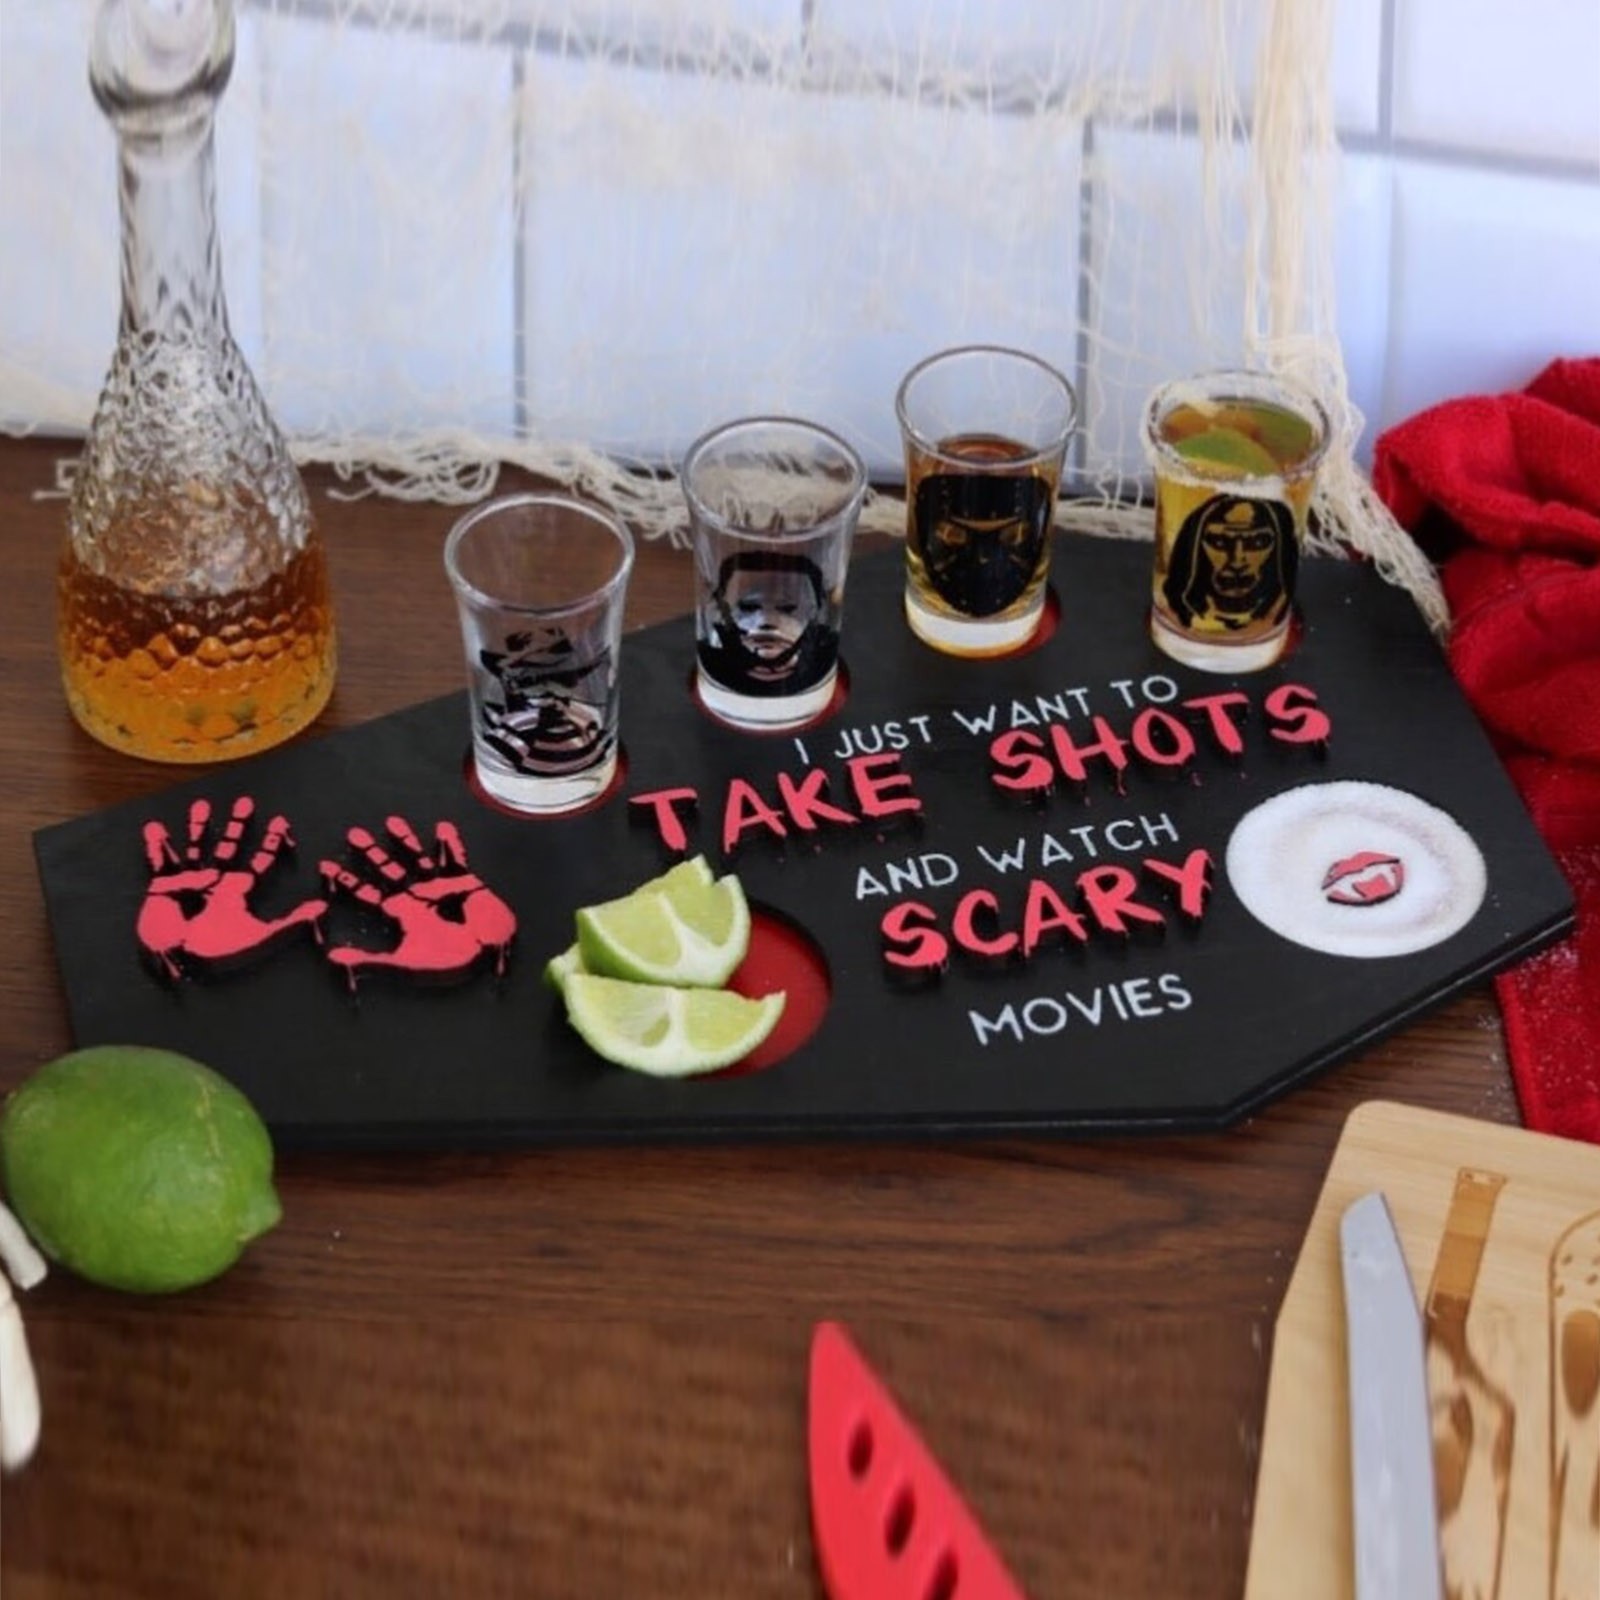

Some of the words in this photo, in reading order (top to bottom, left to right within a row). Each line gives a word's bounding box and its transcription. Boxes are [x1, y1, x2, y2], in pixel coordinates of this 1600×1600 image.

[795, 737, 809, 765] I
[834, 716, 932, 760] JUST
[953, 687, 1090, 734] WANT
[1110, 675, 1178, 709] TO
[629, 752, 921, 852] TAKE
[990, 684, 1331, 792] SHOTS
[855, 852, 958, 900] AND
[977, 812, 1179, 873] WATCH
[881, 849, 1213, 967] SCARY
[968, 973, 1192, 1046] MOVIES
